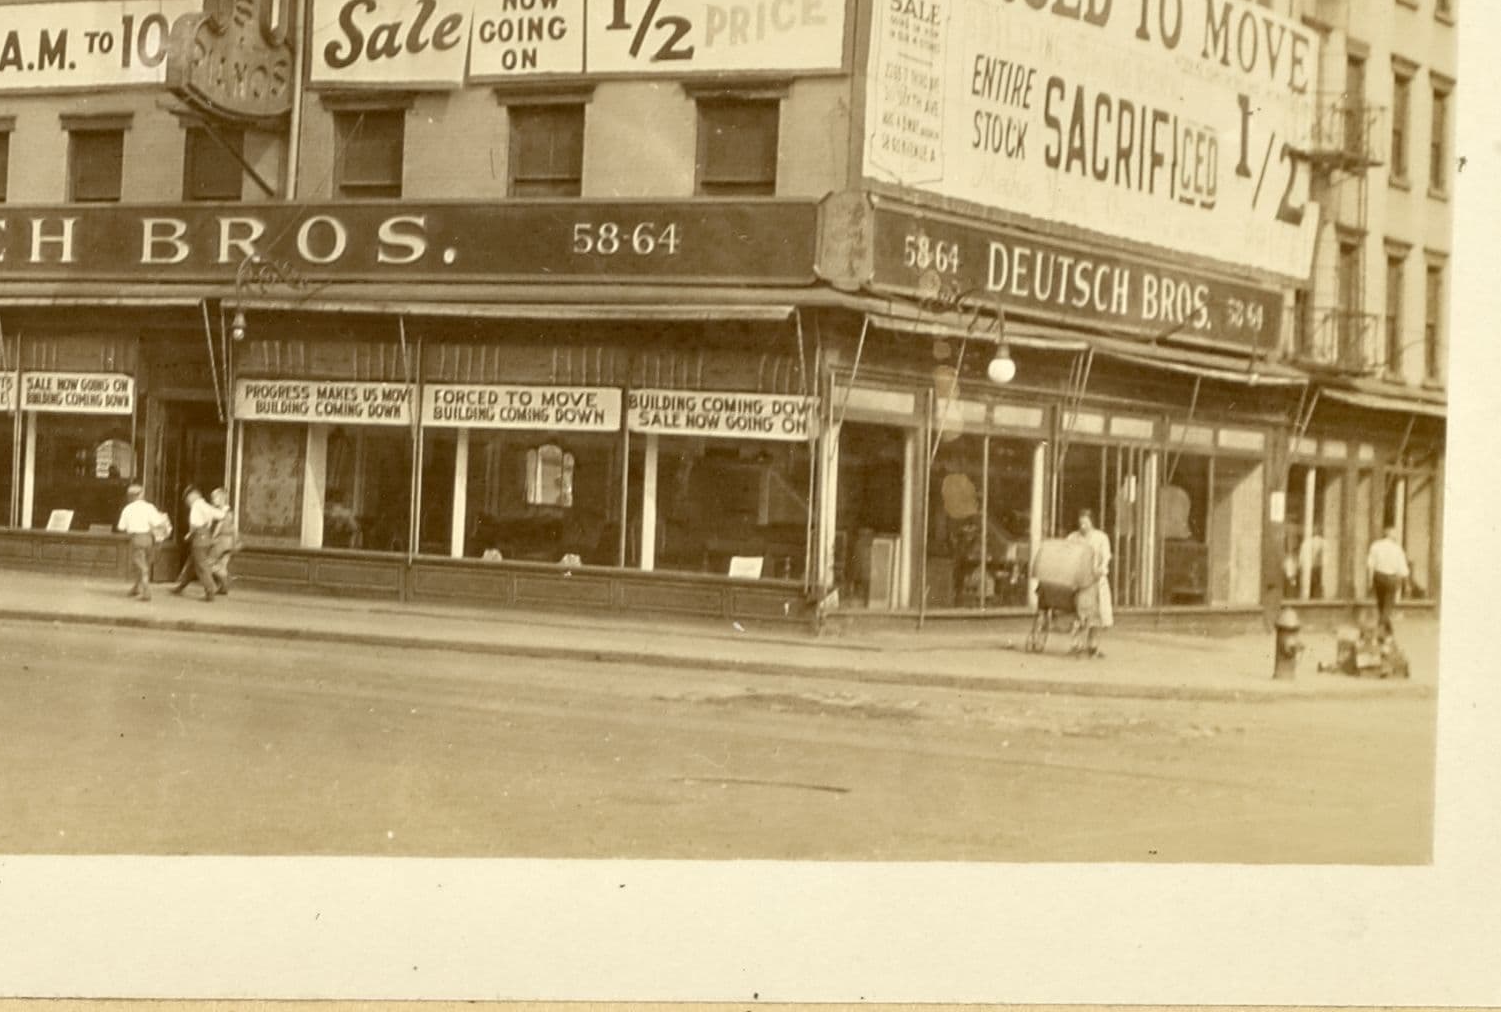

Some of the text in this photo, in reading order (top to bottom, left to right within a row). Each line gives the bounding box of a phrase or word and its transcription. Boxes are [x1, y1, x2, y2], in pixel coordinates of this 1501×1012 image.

[480, 16, 567, 43] GOING
[84, 30, 114, 55] TO
[502, 48, 538, 70] ON
[972, 53, 1036, 110] ENTIRE
[973, 109, 1028, 161] STOCK
[1045, 75, 1309, 227] SACRIFICED 1/2
[140, 215, 456, 265] BROS.
[987, 240, 1131, 315] DEUTSCH
[1141, 274, 1212, 330] BROS.
[26, 376, 52, 390] SALE
[57, 378, 79, 391] NOW
[113, 379, 129, 392] ON
[245, 384, 311, 400] PROGRESS
[316, 385, 358, 402] MAKES
[362, 387, 379, 402] US
[255, 398, 401, 419] BUILDING COMING DOWN
[433, 389, 599, 408] FORCED TO MOVE
[628, 393, 698, 412] BUILDING
[701, 396, 764, 415] COMING
[432, 405, 605, 425] BUILDING COMING DOWN
[638, 412, 808, 434] SALE NOW GOING ON
